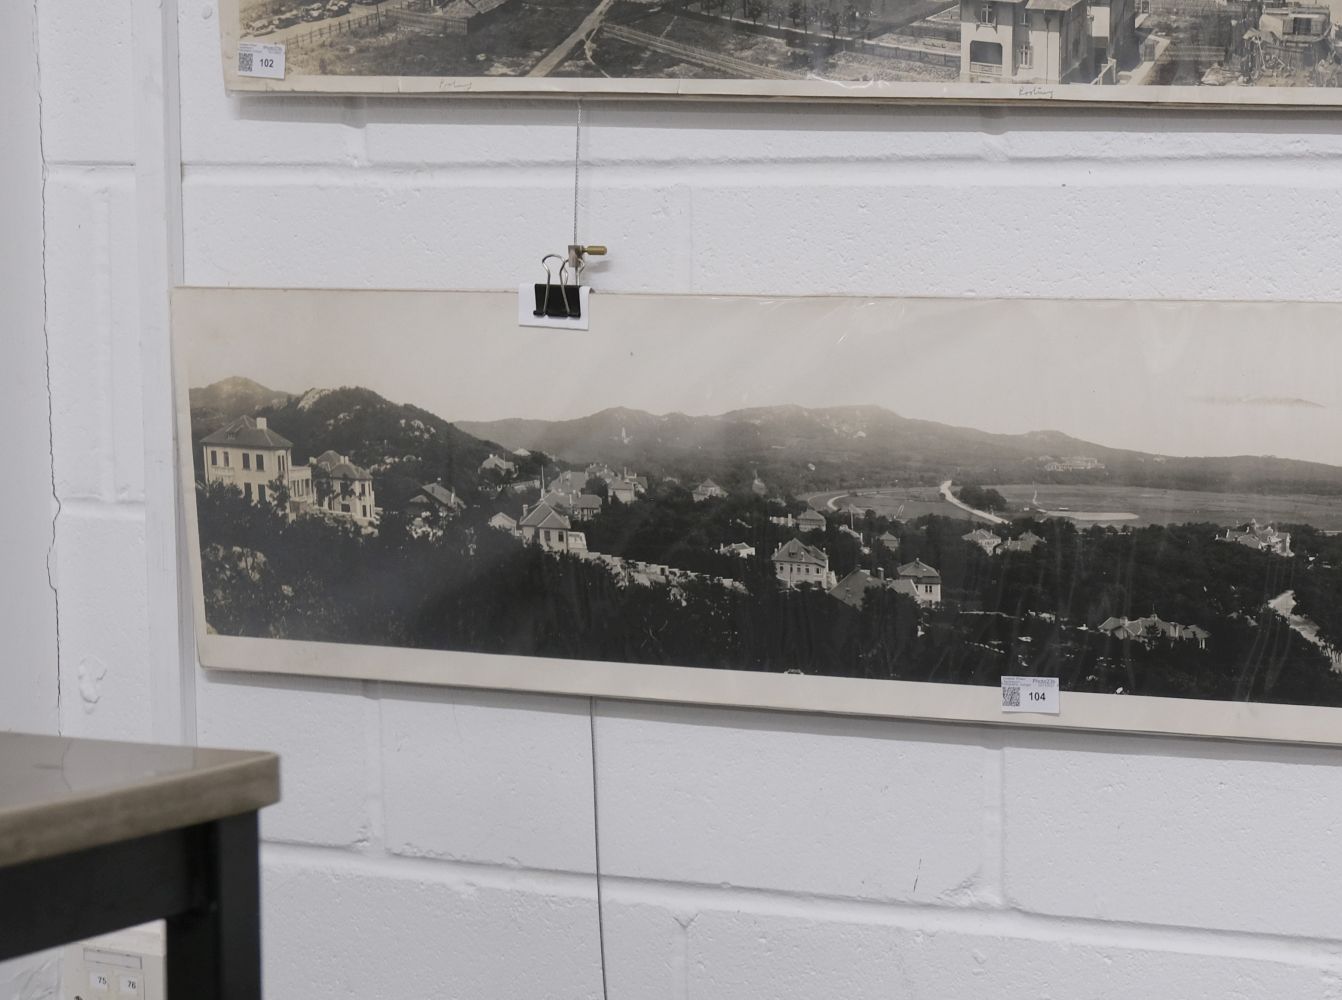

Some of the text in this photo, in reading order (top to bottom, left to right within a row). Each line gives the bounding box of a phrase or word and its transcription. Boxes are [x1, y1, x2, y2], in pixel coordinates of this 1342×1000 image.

[259, 58, 274, 68] 102
[1029, 691, 1046, 702] 104
[97, 976, 107, 985] 75
[127, 980, 137, 989] 76
